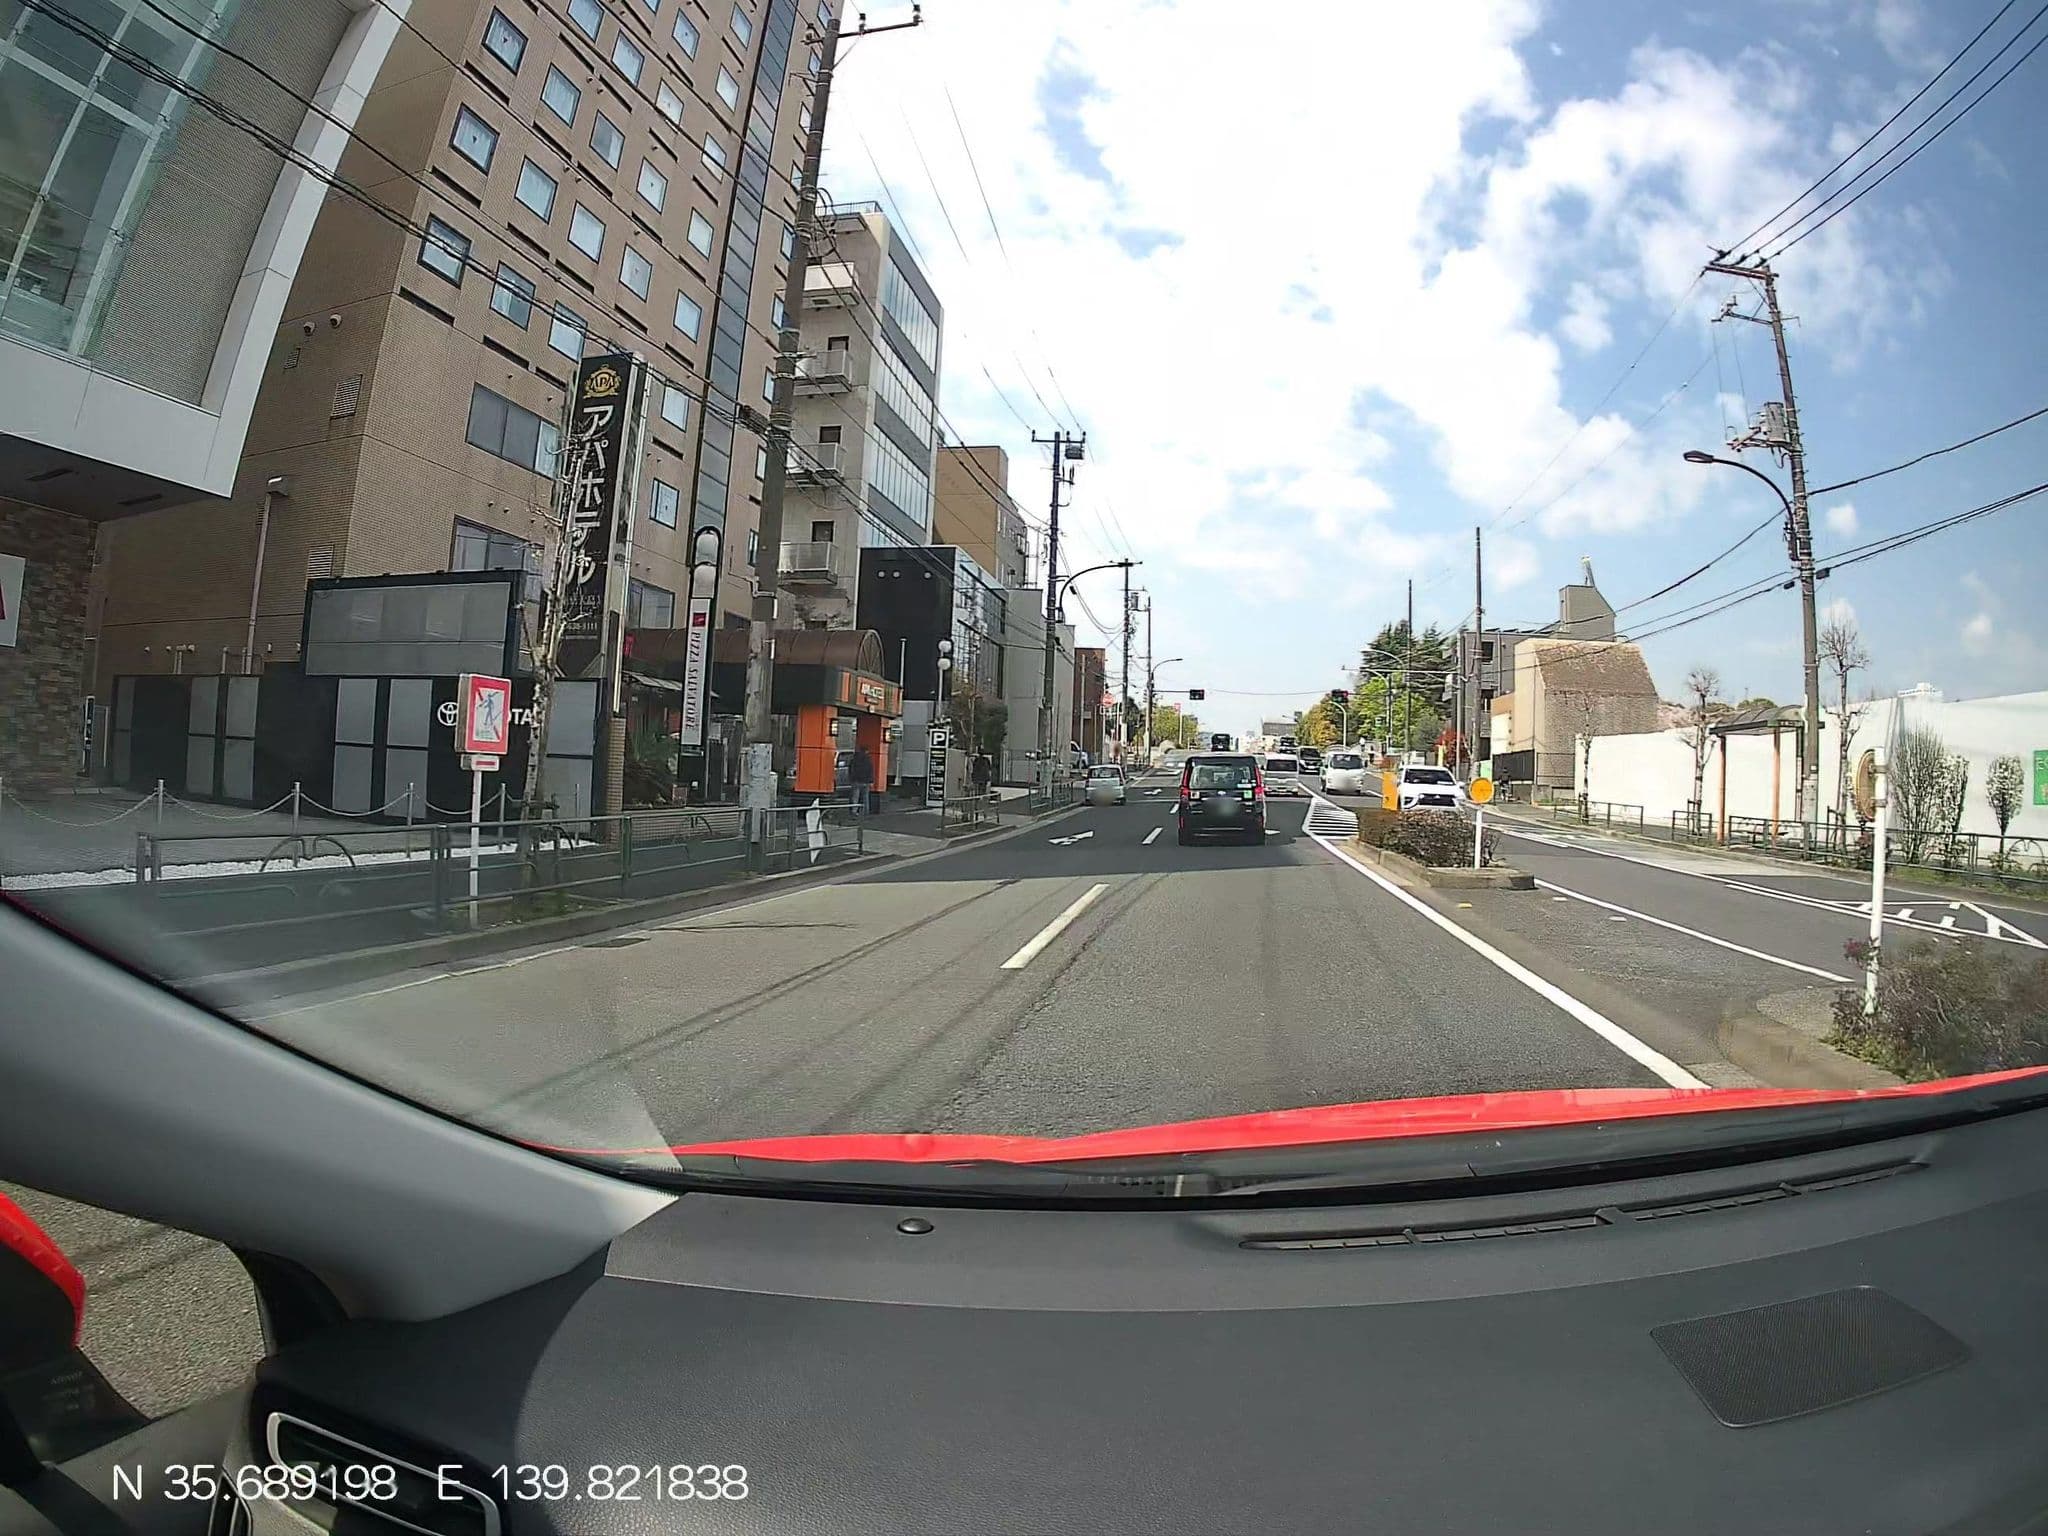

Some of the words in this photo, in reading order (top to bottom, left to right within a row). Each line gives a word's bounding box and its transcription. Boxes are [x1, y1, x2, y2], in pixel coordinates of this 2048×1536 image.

[567, 405, 613, 584] アパホテル
[690, 632, 701, 662] PIZZA
[686, 668, 699, 729] SALVATORE
[933, 732, 945, 745] P
